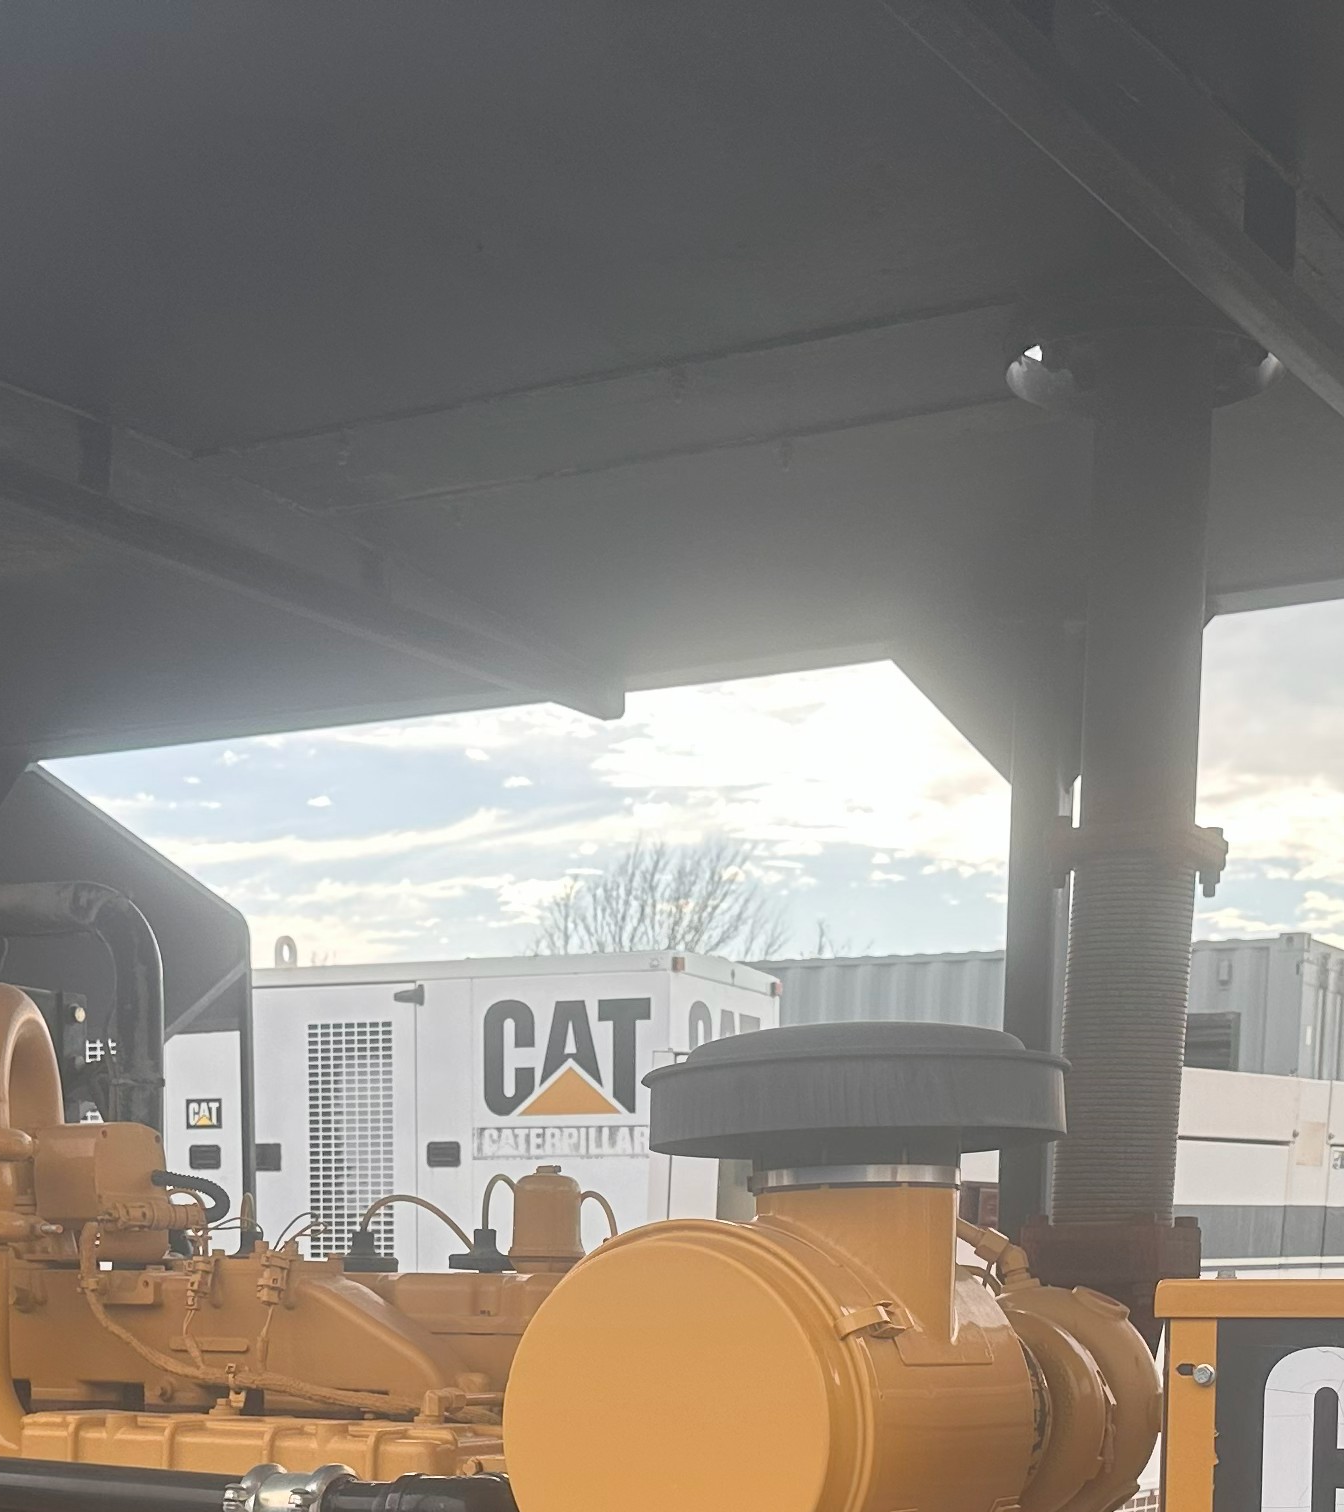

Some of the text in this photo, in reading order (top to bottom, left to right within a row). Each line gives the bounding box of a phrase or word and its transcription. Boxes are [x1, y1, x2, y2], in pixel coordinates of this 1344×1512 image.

[483, 997, 651, 1116] CAT
[188, 1102, 219, 1126] CAT
[482, 1126, 649, 1158] CATERPILLAR
